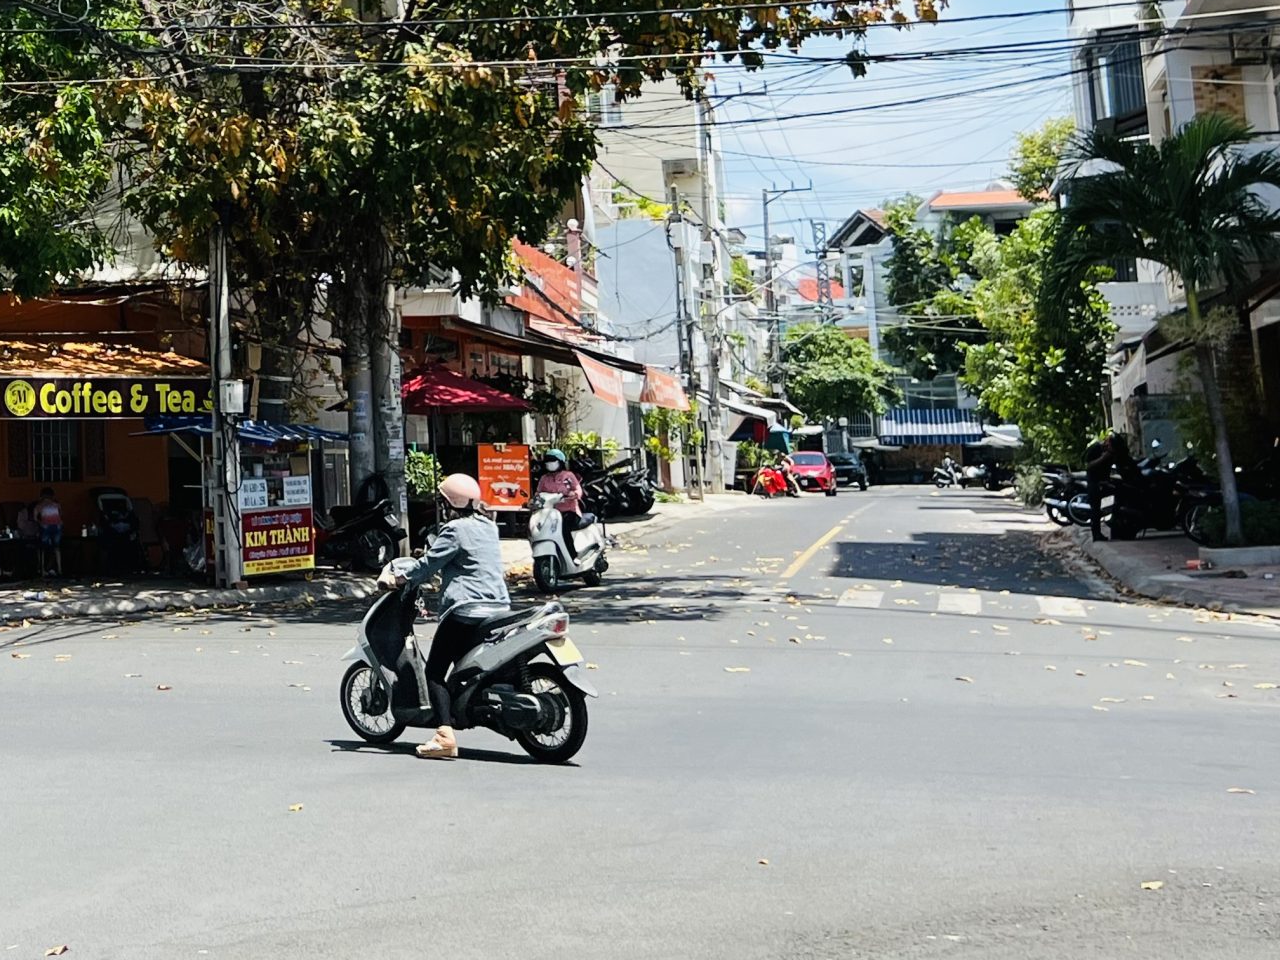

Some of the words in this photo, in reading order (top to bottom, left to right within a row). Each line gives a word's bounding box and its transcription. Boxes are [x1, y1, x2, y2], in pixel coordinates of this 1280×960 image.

[39, 381, 123, 414] Coffee
[130, 383, 149, 413] &
[155, 383, 196, 413] Tea
[245, 530, 267, 548] KIM
[269, 524, 310, 545] THÀNH
